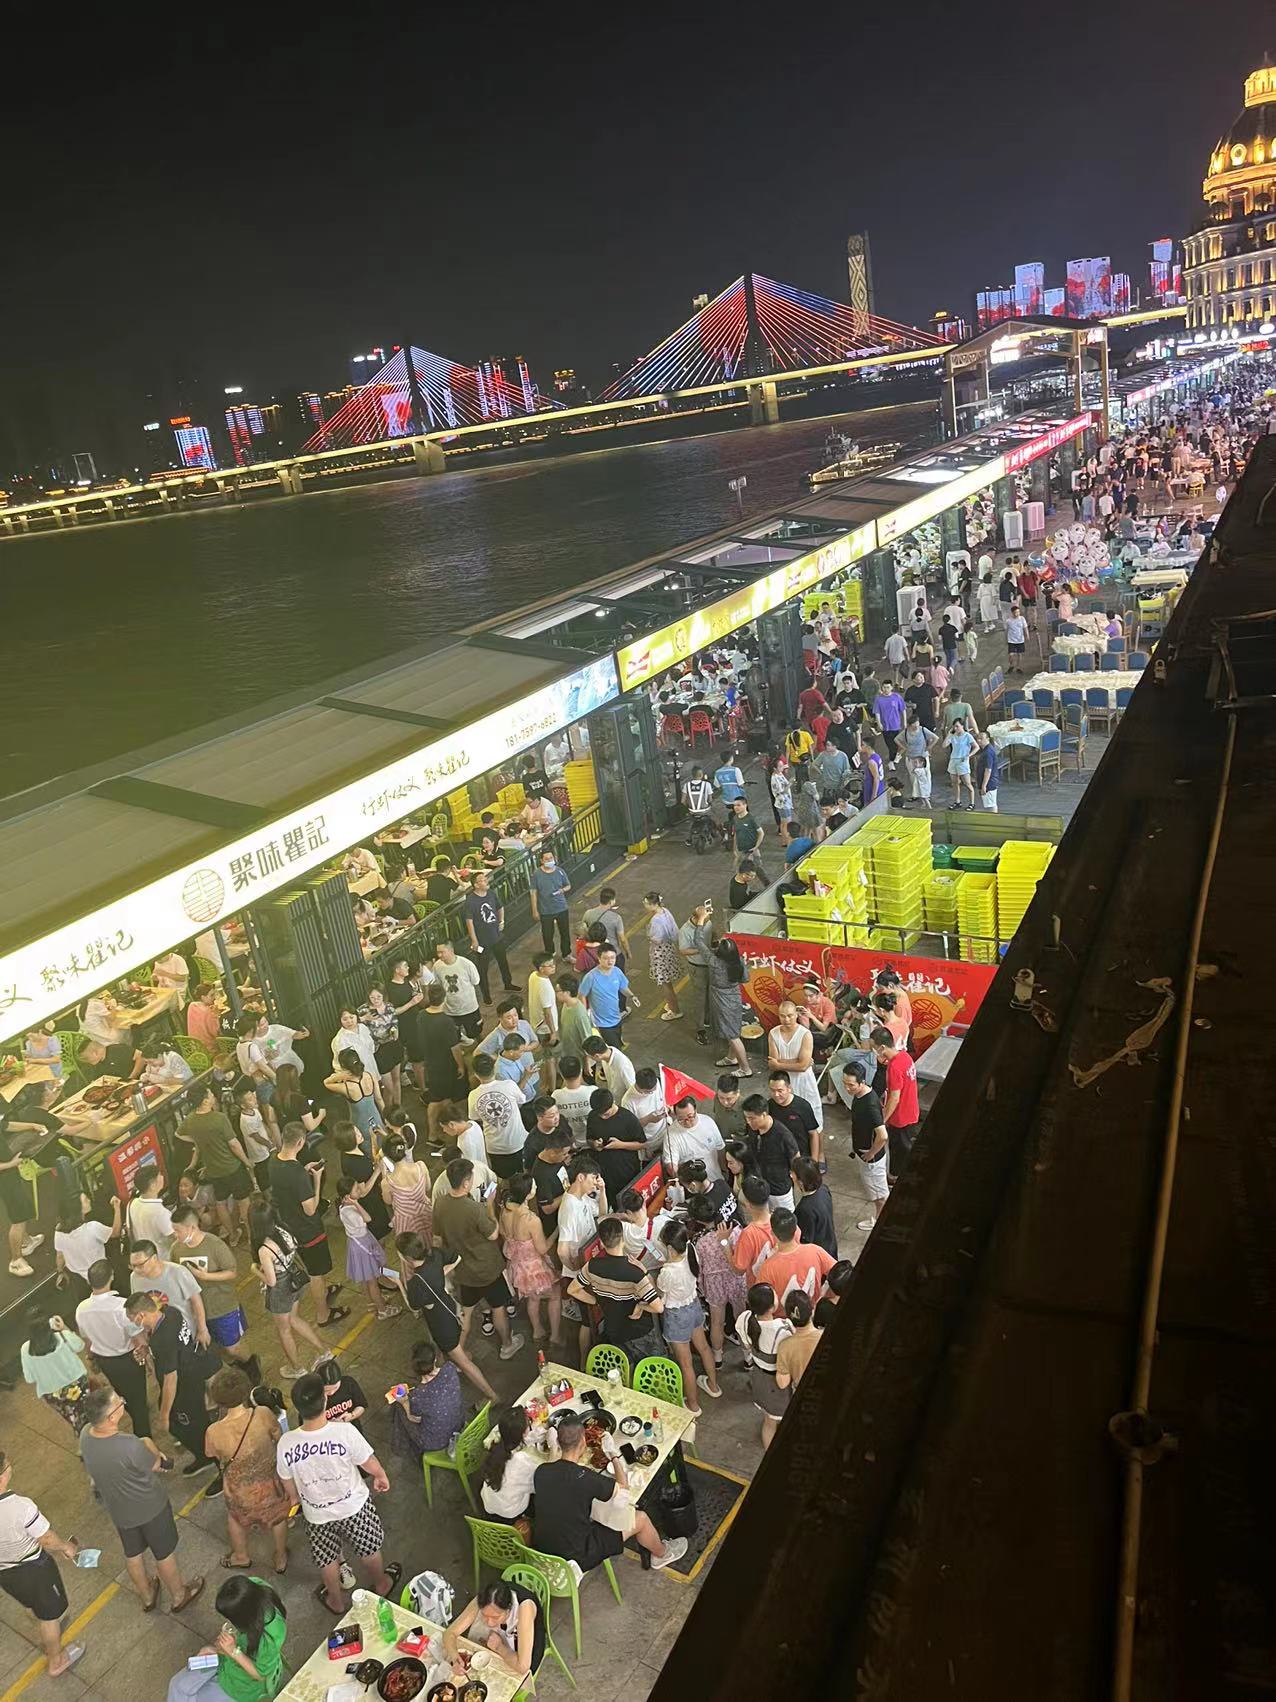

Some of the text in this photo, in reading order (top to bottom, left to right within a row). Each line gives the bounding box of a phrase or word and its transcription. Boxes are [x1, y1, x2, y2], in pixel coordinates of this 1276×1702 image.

[229, 815, 330, 893] 聚味瞿記
[557, 1101, 589, 1110] BOTTEG
